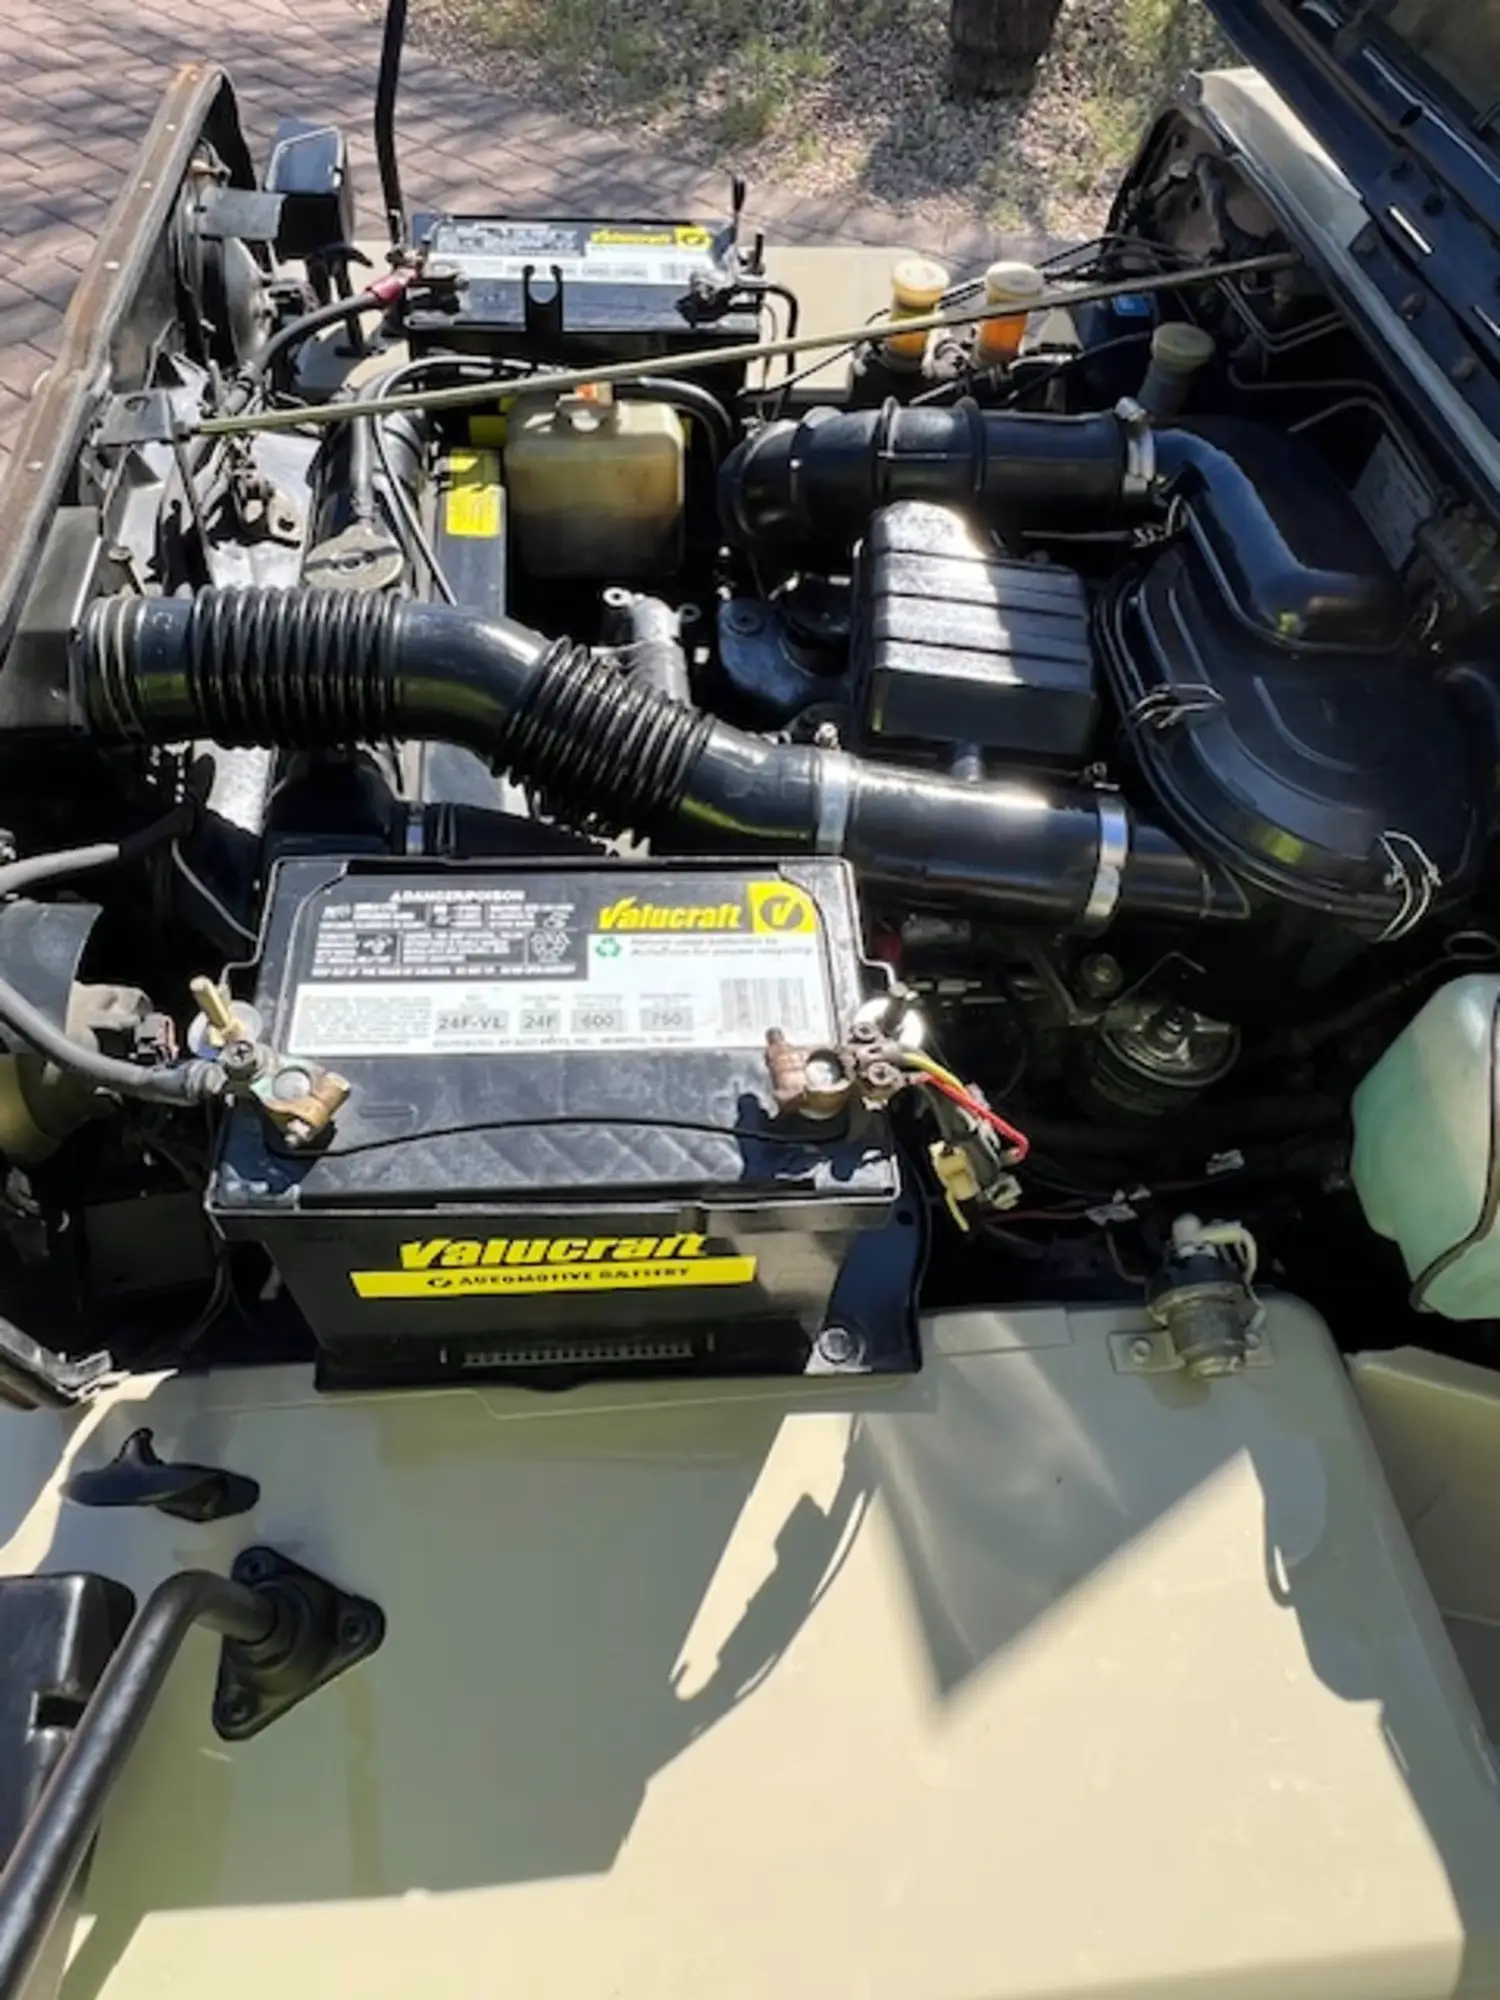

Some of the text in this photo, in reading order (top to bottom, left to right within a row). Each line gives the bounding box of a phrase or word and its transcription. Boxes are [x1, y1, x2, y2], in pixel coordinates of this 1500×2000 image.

[598, 896, 742, 930] Valucraft
[438, 1016, 505, 1030] 24F-VL
[524, 1015, 556, 1029] 24F
[581, 1013, 615, 1027] 600
[650, 1012, 683, 1026] 750
[401, 1232, 707, 1269] Valucraft
[459, 1267, 690, 1286] AUTOMOTIVE BATTERY
